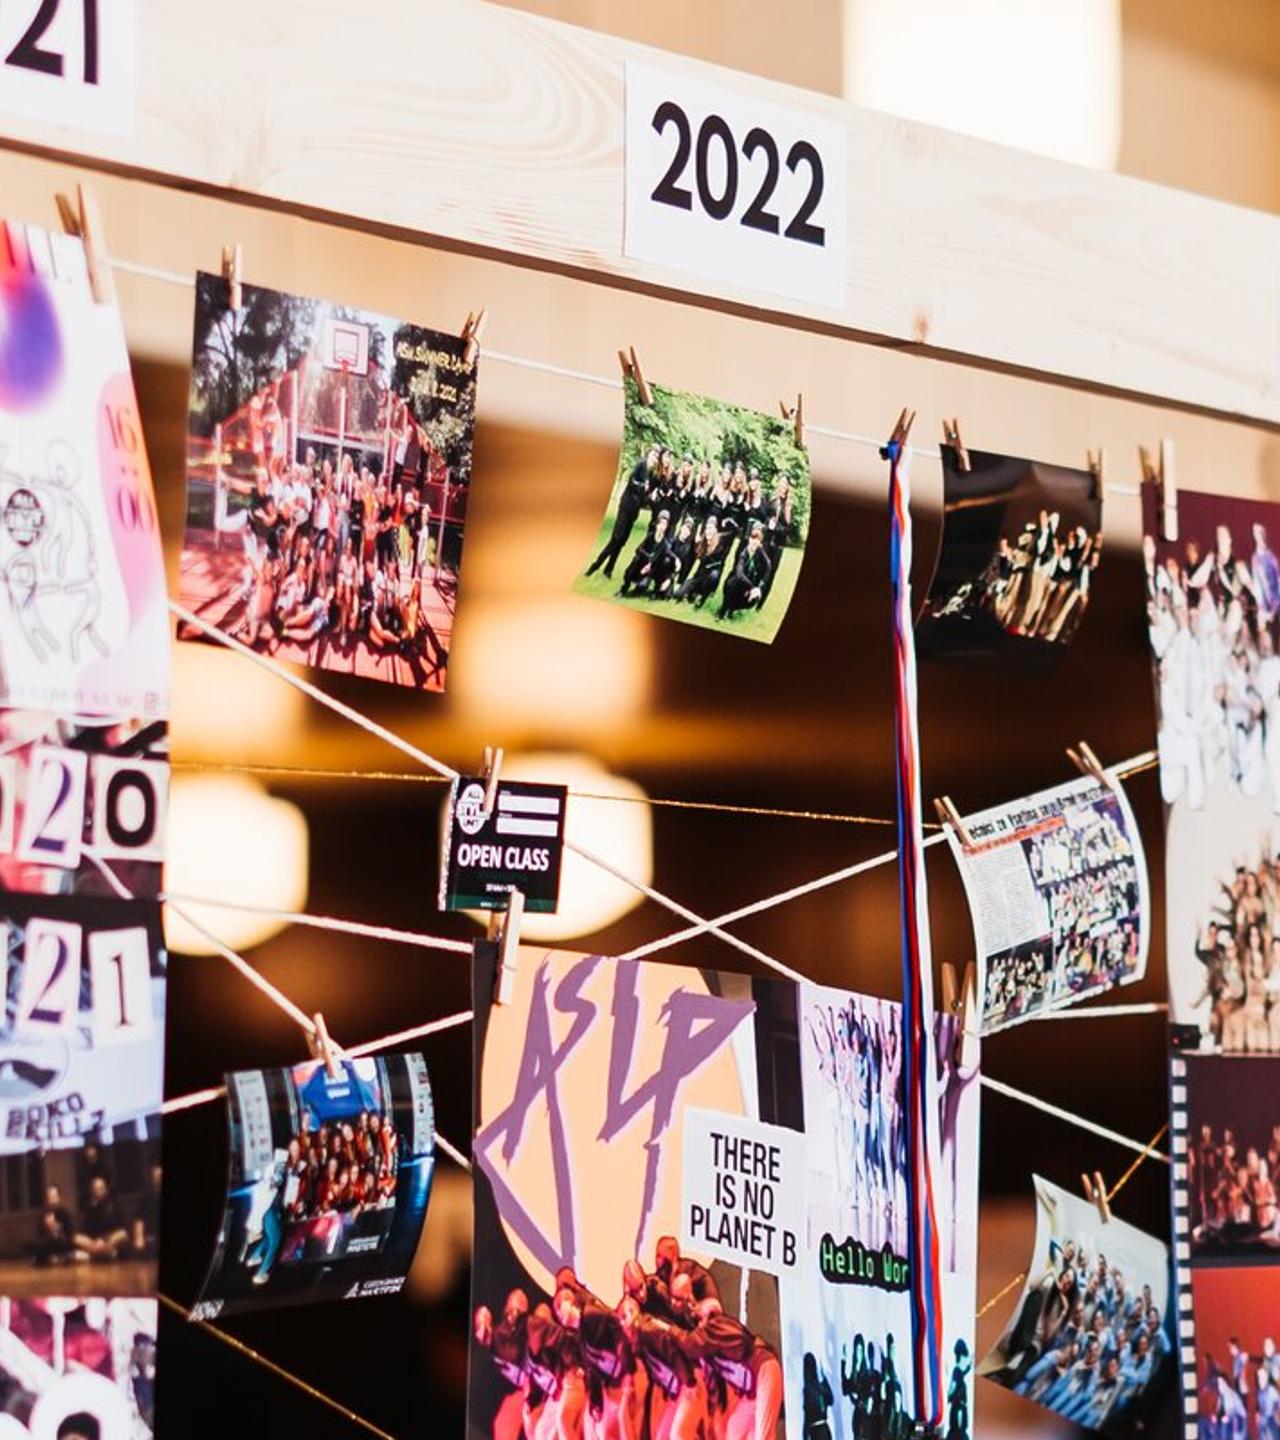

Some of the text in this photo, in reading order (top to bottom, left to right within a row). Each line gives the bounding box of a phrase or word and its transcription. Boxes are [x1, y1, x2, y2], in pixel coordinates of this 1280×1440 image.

[651, 101, 826, 247] 2022
[457, 843, 549, 871] OPEN CLASS
[709, 1131, 781, 1183] THERE
[714, 1171, 774, 1221] IS NO
[690, 1203, 797, 1267] PLANET B
[821, 1241, 910, 1285] Hello Wor
